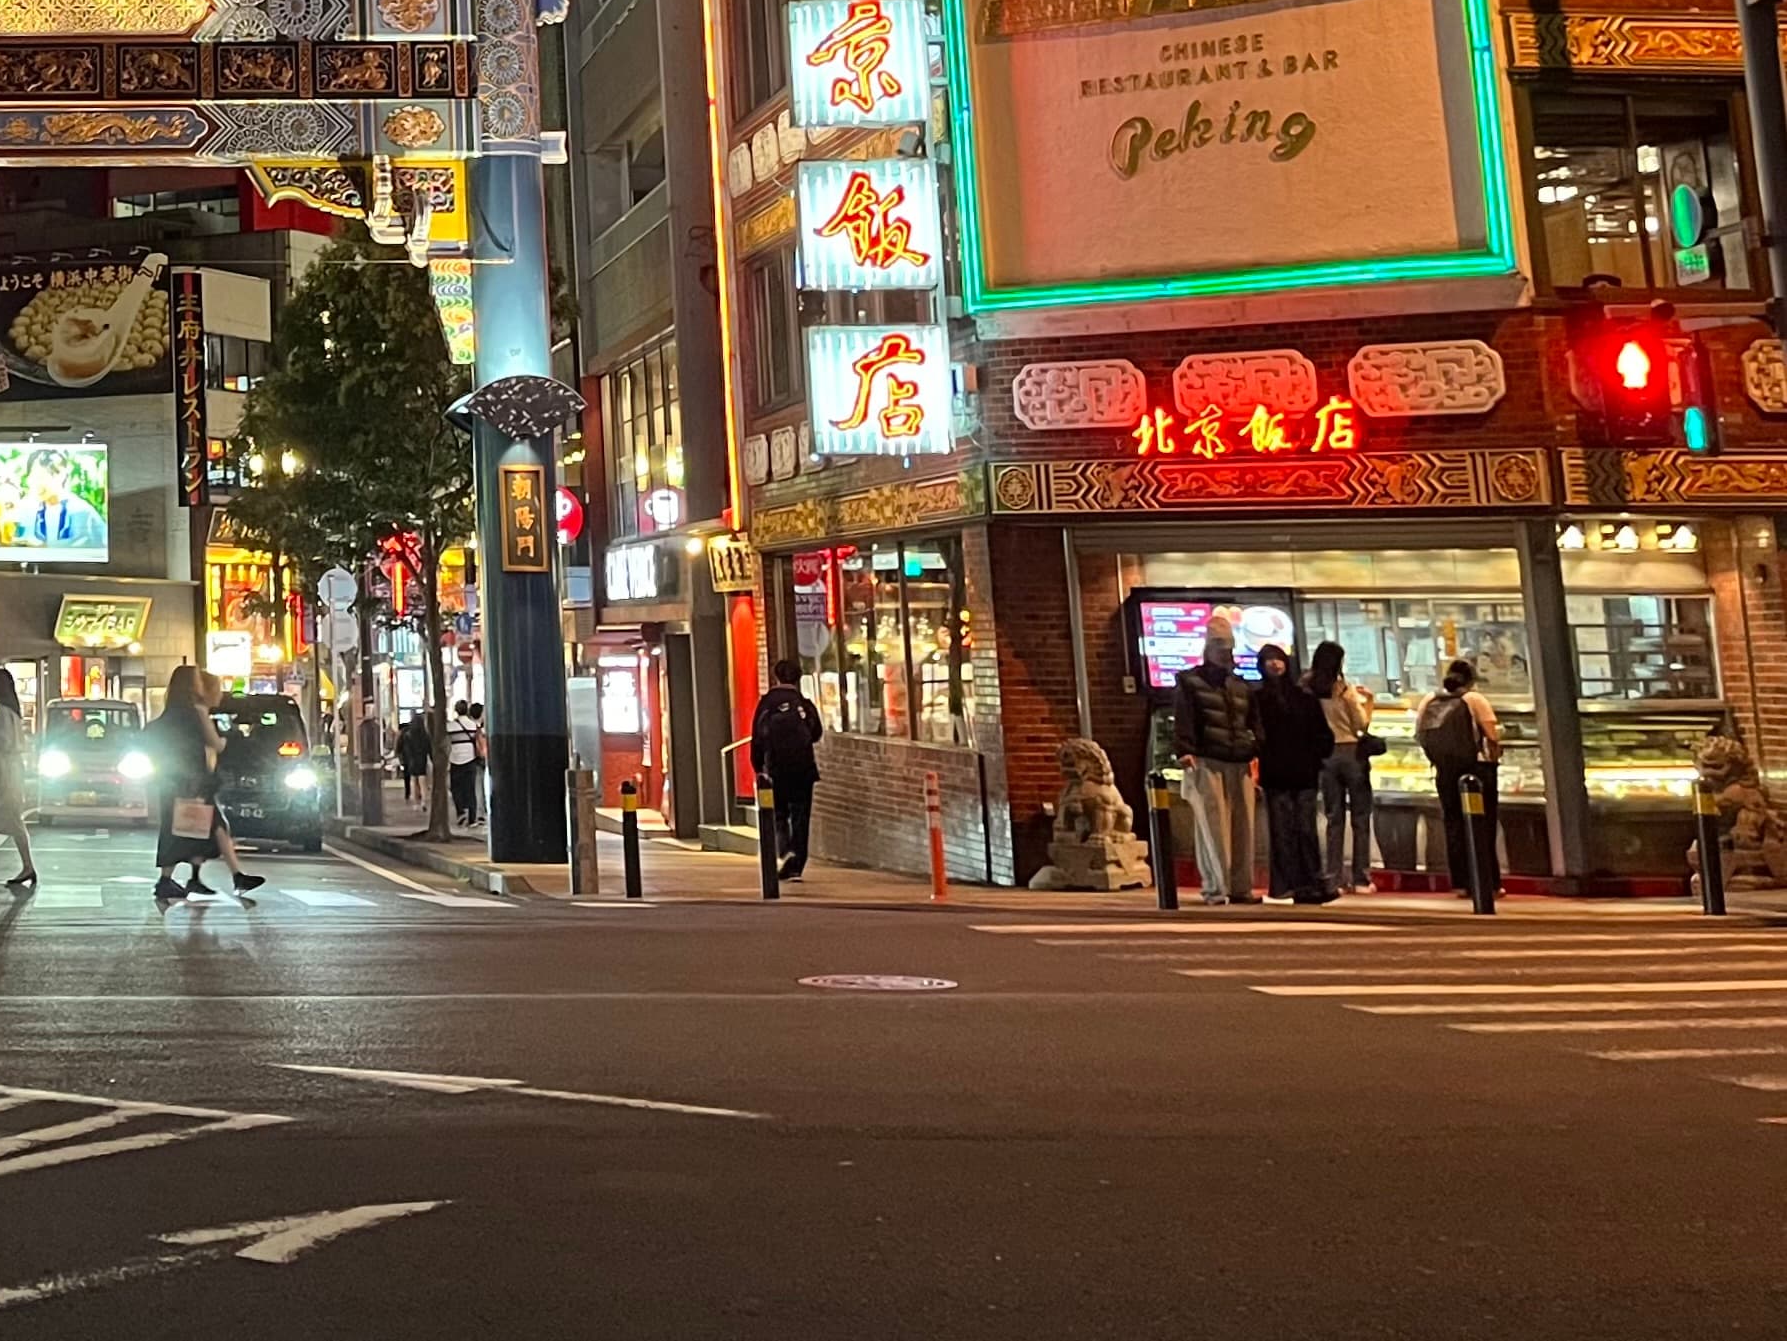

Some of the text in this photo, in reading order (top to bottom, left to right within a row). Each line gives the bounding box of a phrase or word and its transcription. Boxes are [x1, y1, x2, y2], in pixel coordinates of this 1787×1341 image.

[1079, 60, 1249, 99] RESTAURANT
[1283, 49, 1339, 76] BAR
[1160, 33, 1265, 64] CHINESE
[1110, 99, 1318, 181] Peking
[0, 273, 44, 292] ようこそ
[176, 293, 204, 493] 王府井レストラン
[1133, 398, 1354, 459] 北京飯店
[511, 474, 536, 558] 朝陽門
